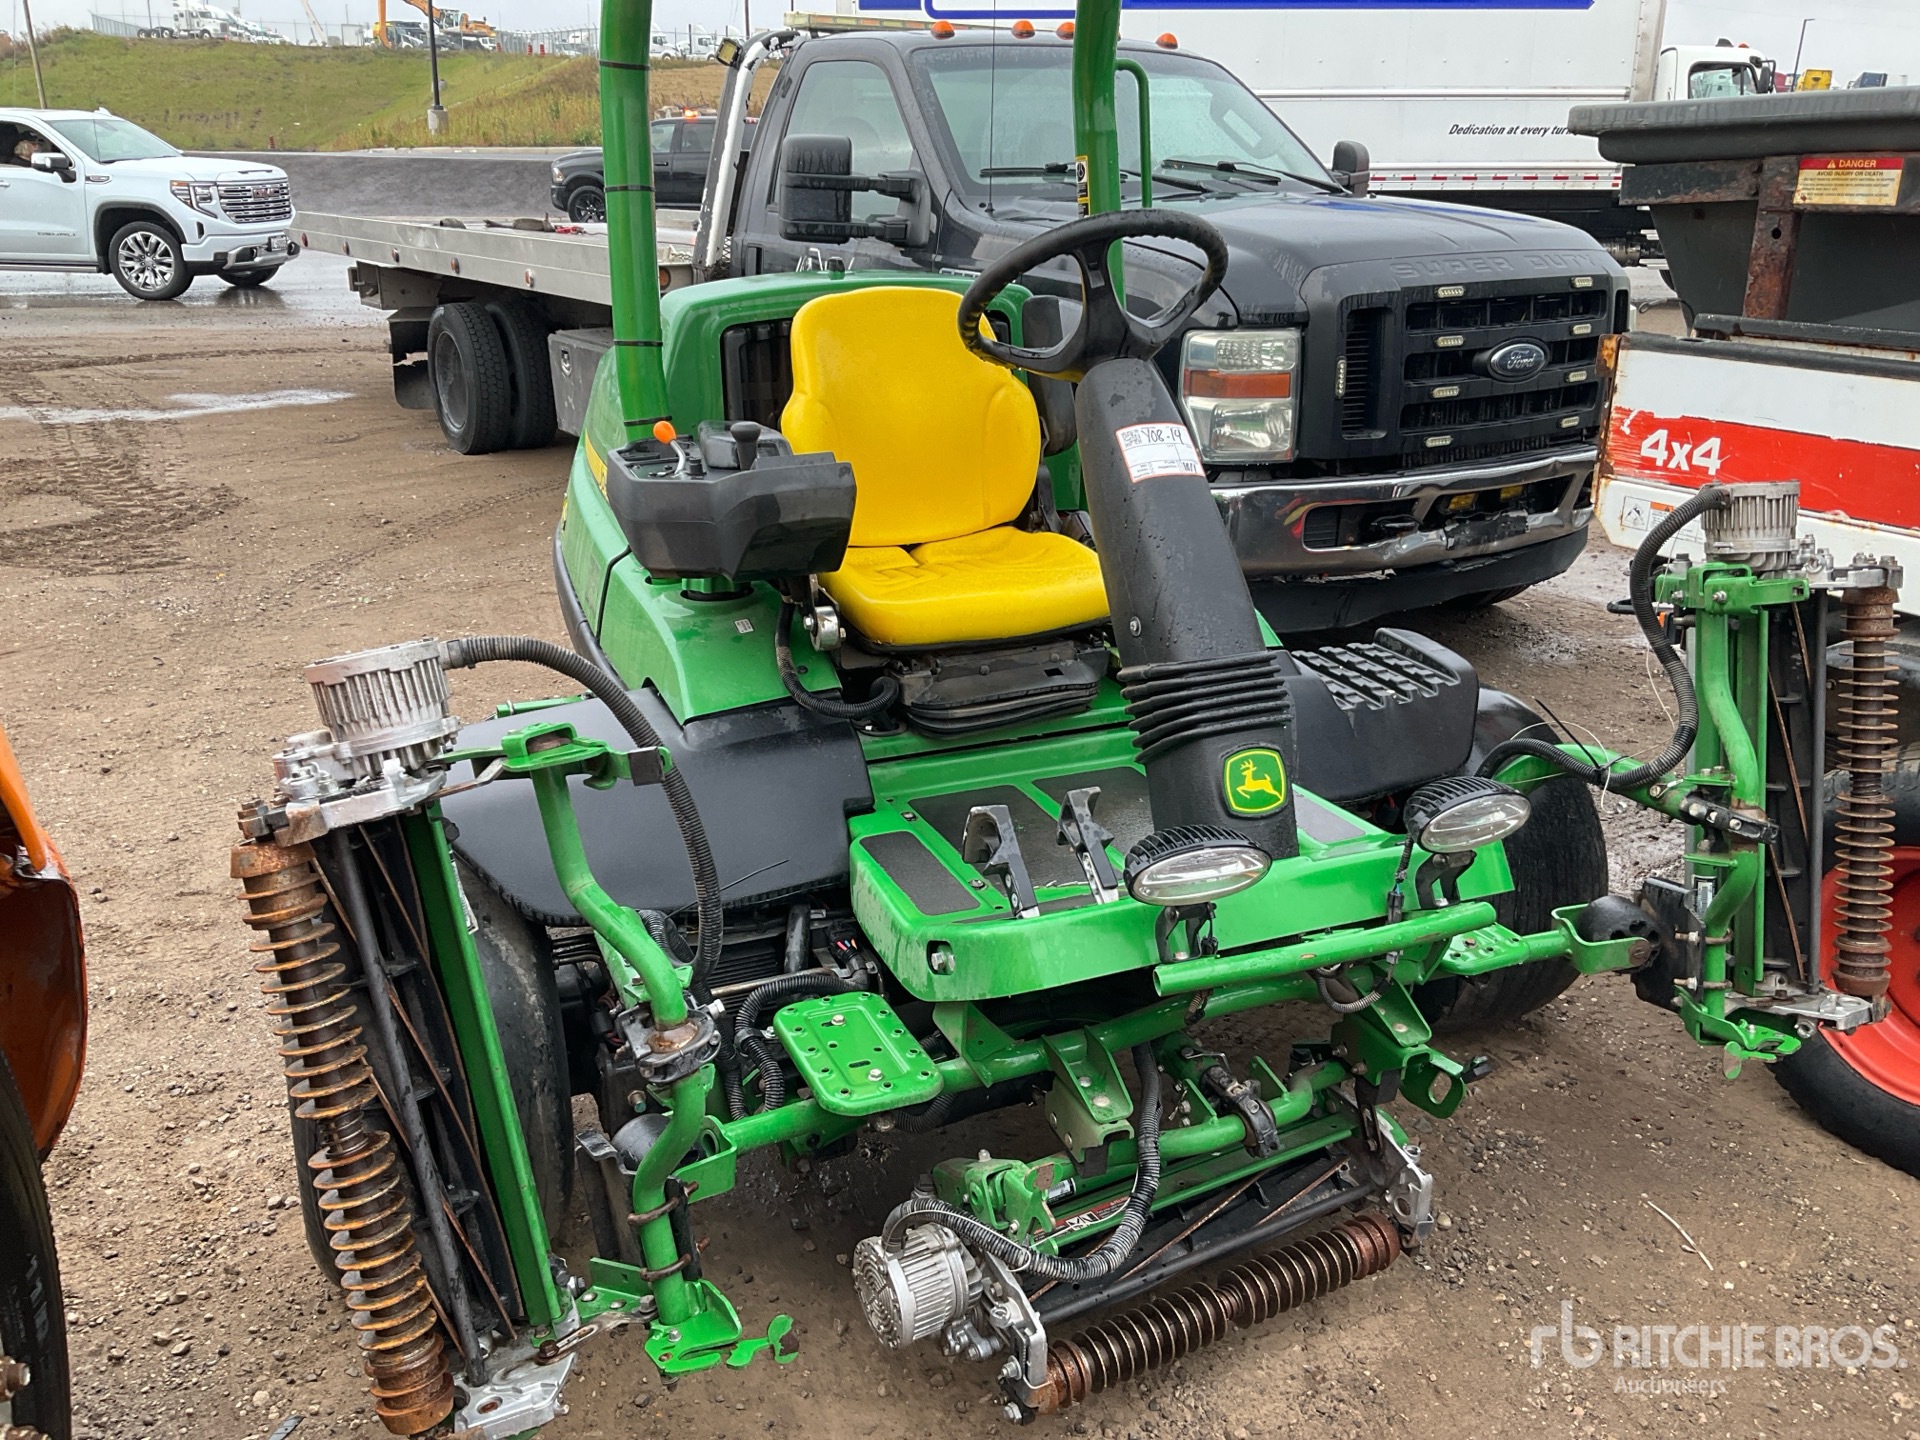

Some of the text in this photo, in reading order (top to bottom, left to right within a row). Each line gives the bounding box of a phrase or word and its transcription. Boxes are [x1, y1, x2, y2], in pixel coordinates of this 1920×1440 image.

[1449, 124, 1505, 135] Dedication
[1507, 125, 1520, 134] at
[1520, 126, 1550, 137] every
[1838, 160, 1877, 168] DANGER
[1390, 254, 1595, 279] SUPER DUTY
[1507, 350, 1536, 369] Ford
[1640, 429, 1721, 476] 4x4
